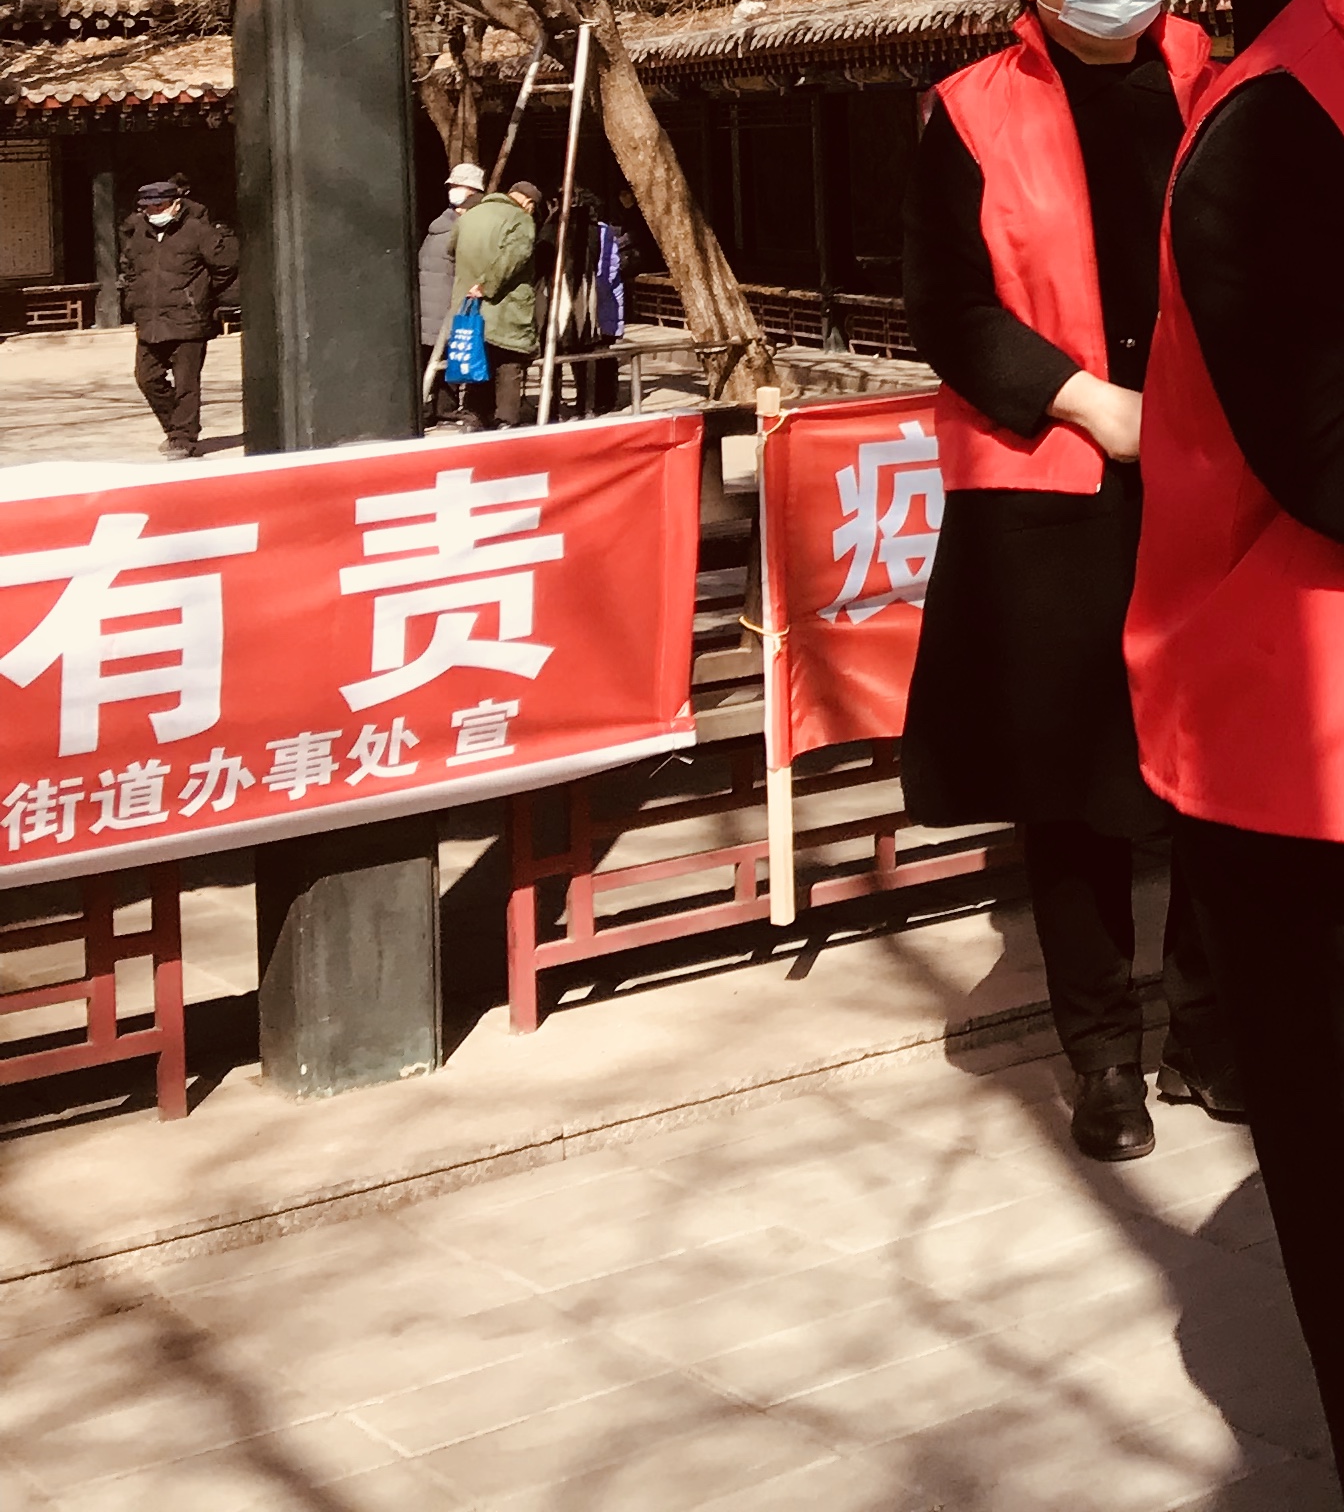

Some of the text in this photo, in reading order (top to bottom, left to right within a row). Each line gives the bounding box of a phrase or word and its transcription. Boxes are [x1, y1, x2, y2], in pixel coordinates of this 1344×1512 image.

[816, 420, 946, 625] 疫
[0, 698, 521, 852] 街道办事处 宣
